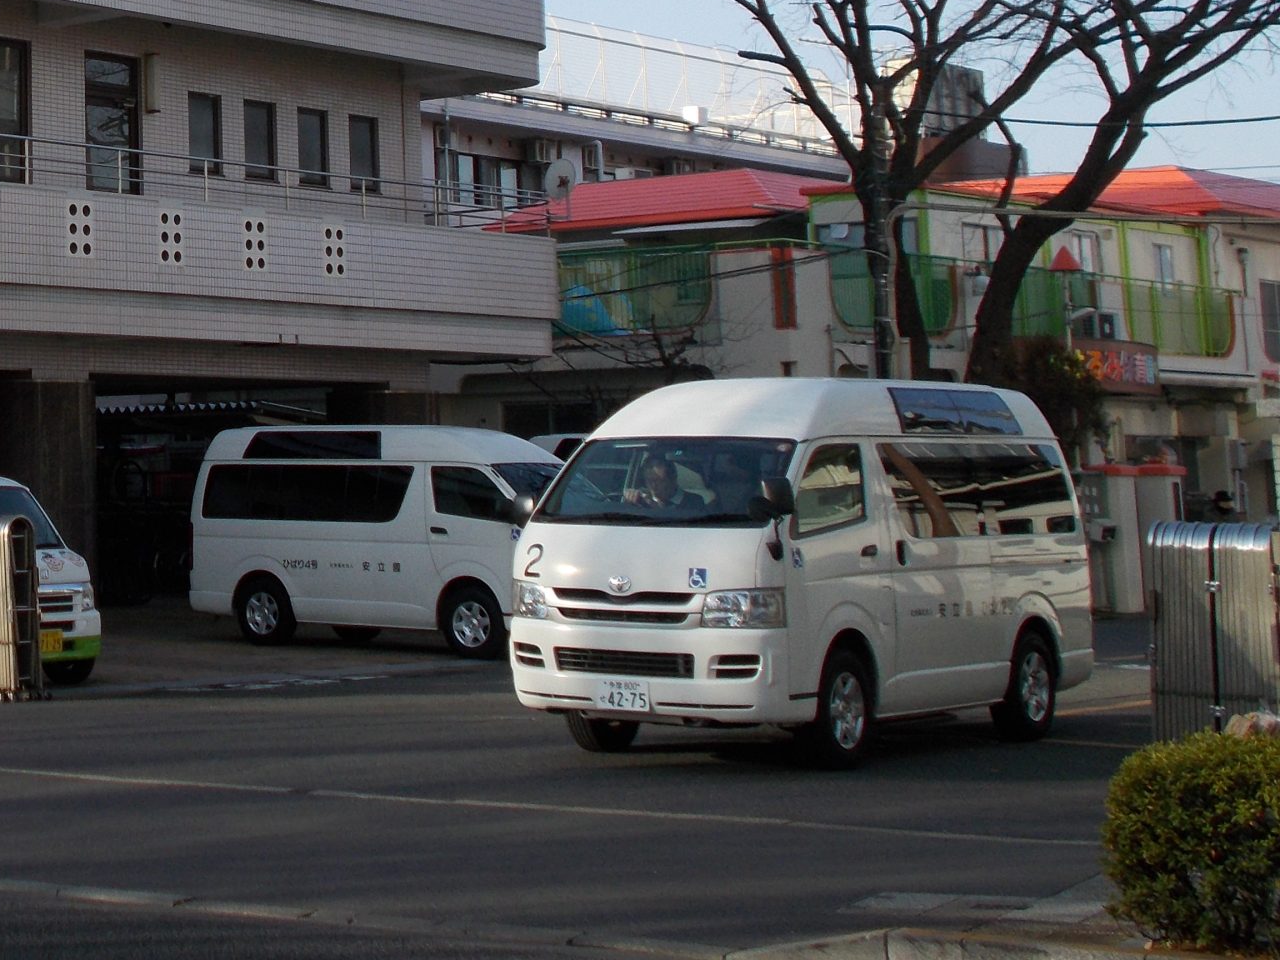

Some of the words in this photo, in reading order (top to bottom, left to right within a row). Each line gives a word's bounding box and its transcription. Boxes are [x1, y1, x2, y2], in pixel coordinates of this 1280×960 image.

[282, 558, 318, 570] ひばり4号
[524, 543, 544, 577] 2
